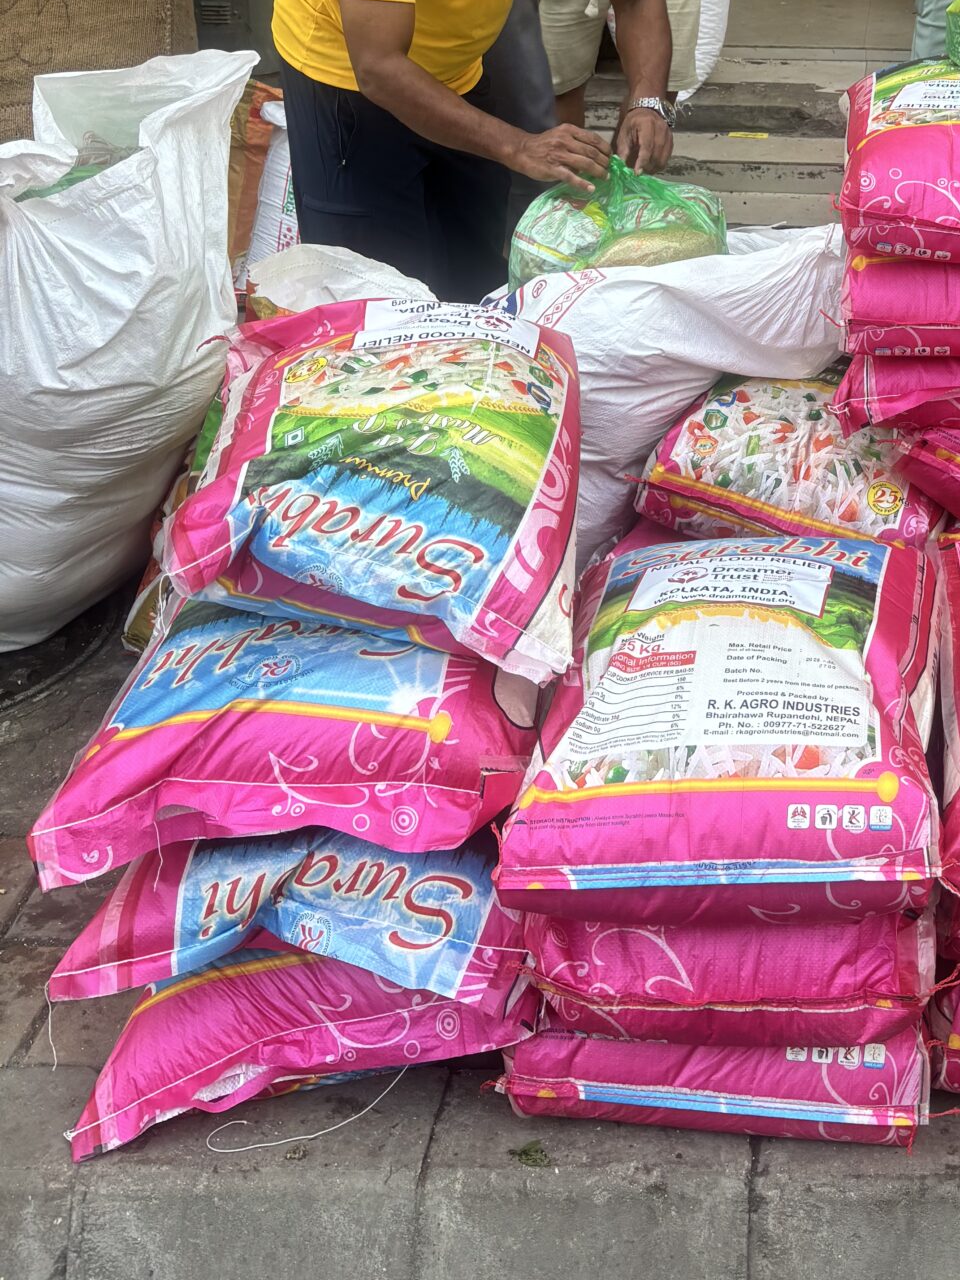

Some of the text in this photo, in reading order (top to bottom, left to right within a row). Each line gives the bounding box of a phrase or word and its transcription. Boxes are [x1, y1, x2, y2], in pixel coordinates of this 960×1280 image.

[358, 334, 414, 349] RELIEF
[875, 489, 897, 503] 25
[621, 538, 869, 578] Surabhi
[651, 556, 829, 572] NEPAL FLOOD RELIEF
[712, 566, 796, 576] Dreamer
[712, 573, 759, 581] Trust
[660, 586, 793, 598] KOLKATA, INDIA.
[654, 593, 796, 605] Web: www.dreamertrust.org
[639, 643, 665, 655] Kg.
[749, 642, 771, 650] Retail
[773, 645, 792, 653] Price
[639, 653, 694, 666] Information
[756, 655, 788, 665] Packing
[788, 691, 817, 700] Packed
[819, 694, 829, 702] by
[707, 698, 861, 717] R. K. AGRO INDUSTRIES
[575, 717, 593, 731] Sodium
[706, 711, 861, 725] Bhairahawa Rupandehi, NEPAL
[763, 721, 846, 731] 00977-71-522627
